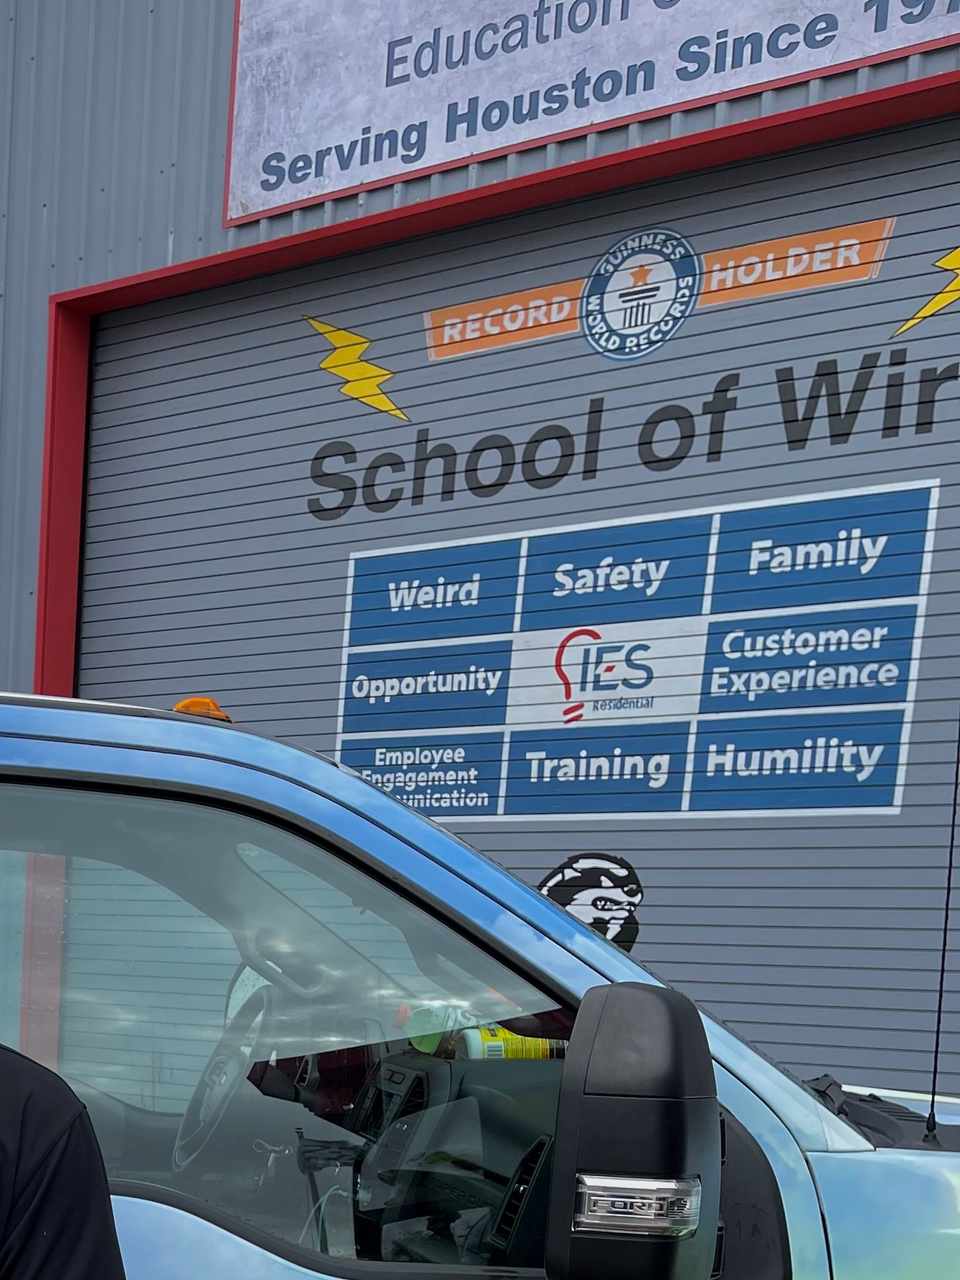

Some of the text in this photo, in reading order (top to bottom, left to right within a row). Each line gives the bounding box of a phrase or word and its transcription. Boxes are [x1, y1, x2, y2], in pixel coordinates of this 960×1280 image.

[385, 0, 630, 88] Education
[260, 0, 960, 192] Serving Houston Since 19
[600, 233, 686, 277] GUINNESS
[442, 237, 862, 345] RECORD HOLDER
[587, 275, 694, 353] WORLD RECORDS
[307, 397, 605, 522] School
[637, 372, 742, 473] of
[748, 527, 889, 576] Family
[387, 572, 481, 612] Weird
[552, 556, 671, 597] Safety
[722, 625, 889, 660] Customer
[351, 664, 503, 704] Opportunity
[579, 643, 655, 693] IES
[709, 659, 900, 702] Experience
[591, 696, 655, 712] Residential
[361, 767, 479, 792] Engagement
[374, 747, 466, 770] Employee
[525, 746, 671, 788] Training
[705, 736, 886, 783] Humility
[396, 788, 490, 808] unication
